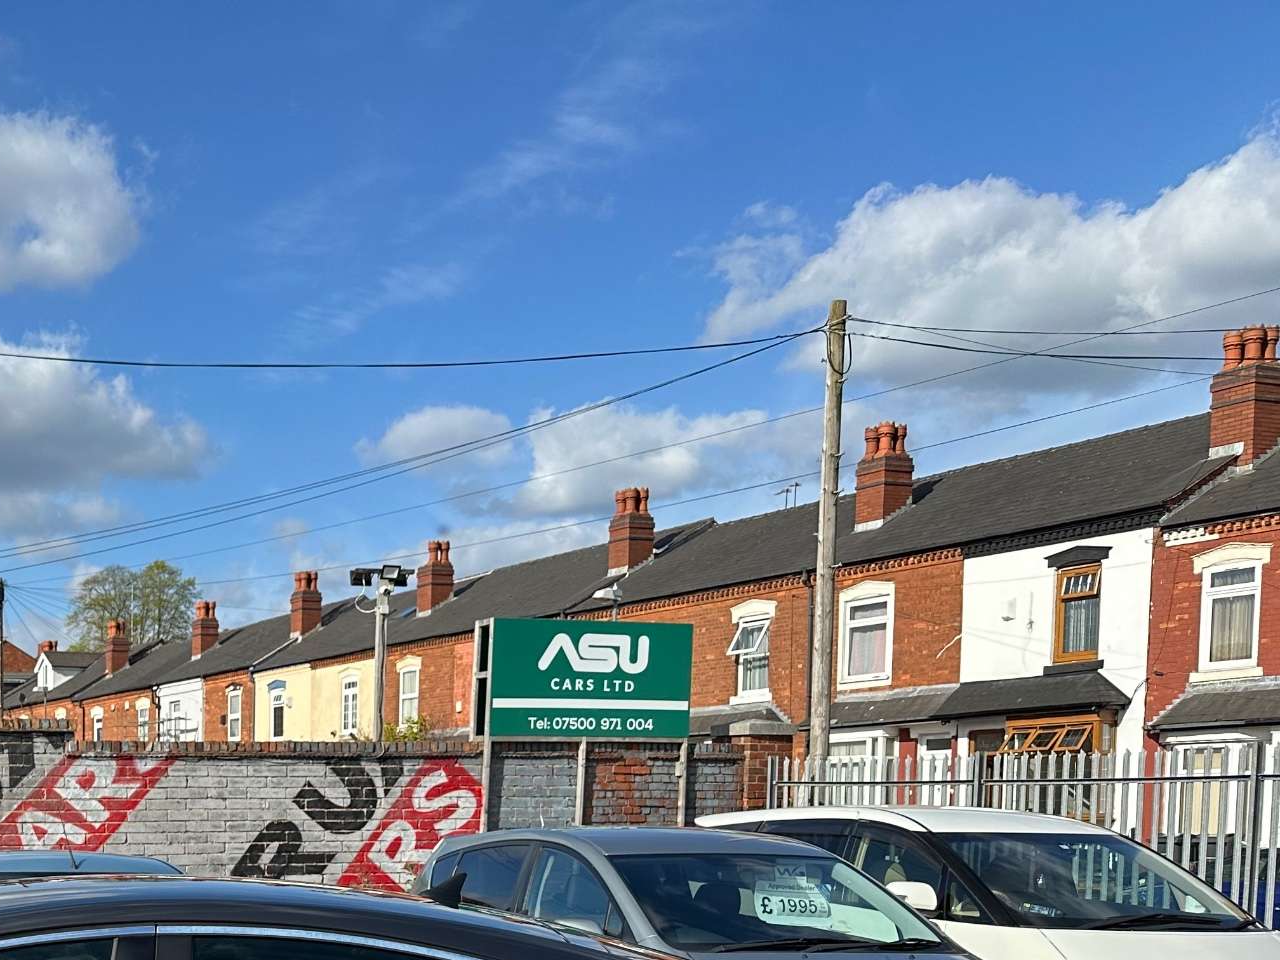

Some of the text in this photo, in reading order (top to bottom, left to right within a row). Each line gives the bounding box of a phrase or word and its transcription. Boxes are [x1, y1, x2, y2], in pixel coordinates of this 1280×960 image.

[537, 632, 650, 674] ASU
[551, 678, 635, 693] CARS LTD
[528, 717, 653, 731] Tel: 07500 971 004
[779, 898, 818, 914] 1995
